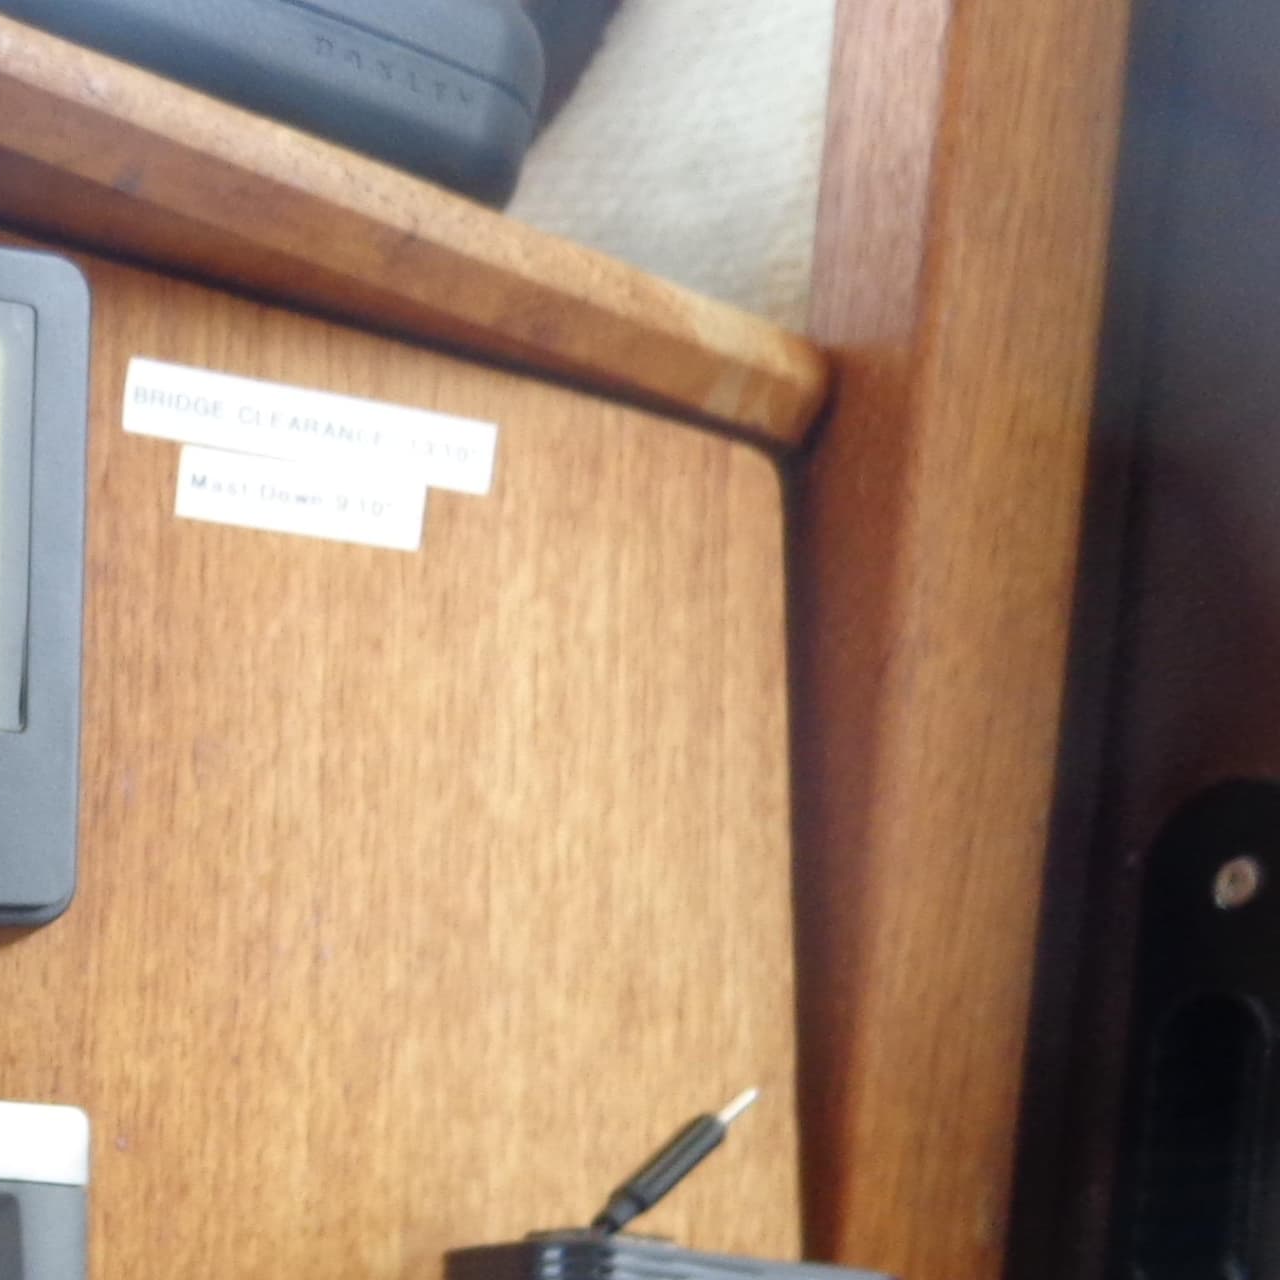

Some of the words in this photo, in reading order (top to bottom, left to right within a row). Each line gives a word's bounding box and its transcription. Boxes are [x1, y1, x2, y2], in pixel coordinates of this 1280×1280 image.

[132, 384, 225, 420] BRIDGE
[237, 404, 384, 448] CLEARANCE
[190, 472, 248, 496] Mast
[260, 483, 324, 506] Down
